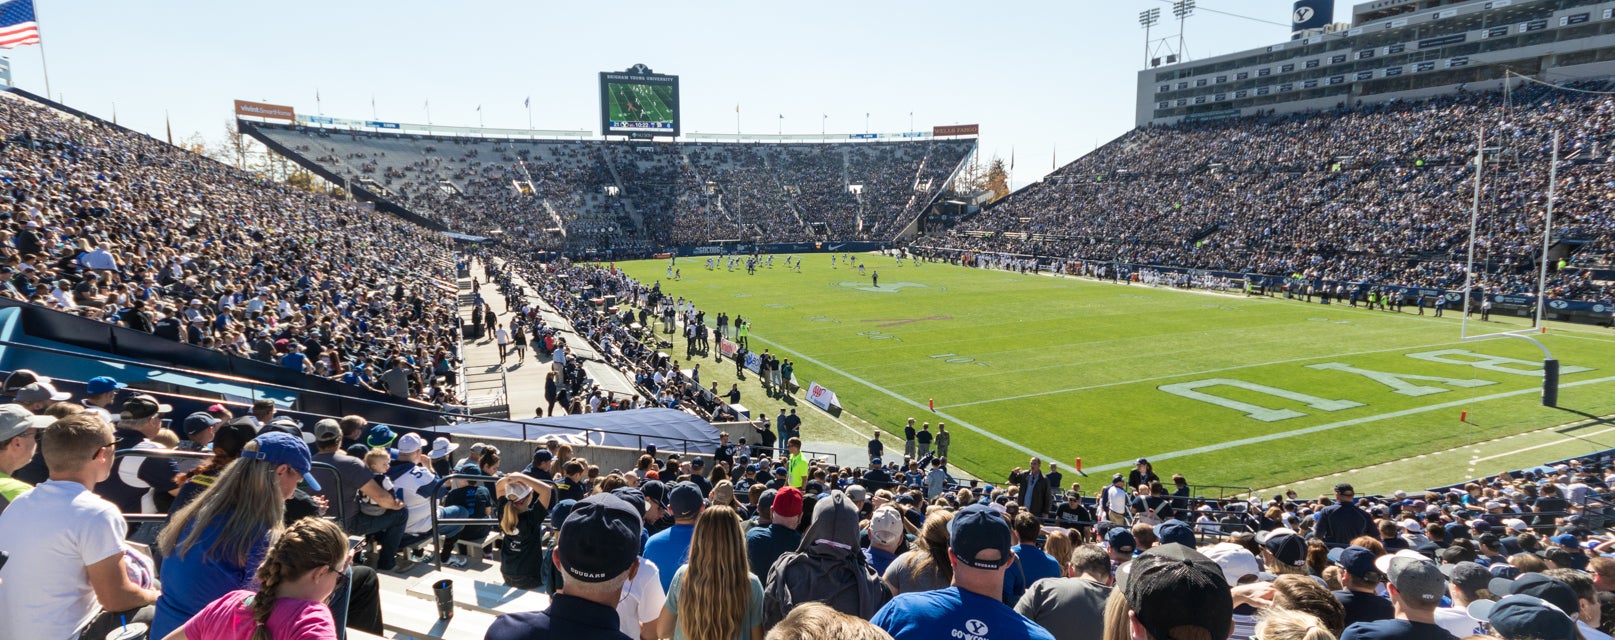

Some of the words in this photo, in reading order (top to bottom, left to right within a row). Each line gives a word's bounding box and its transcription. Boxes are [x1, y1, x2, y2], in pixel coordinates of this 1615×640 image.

[634, 65, 647, 74] Y
[974, 561, 998, 569] COUGARS
[570, 567, 606, 578] COUGARS
